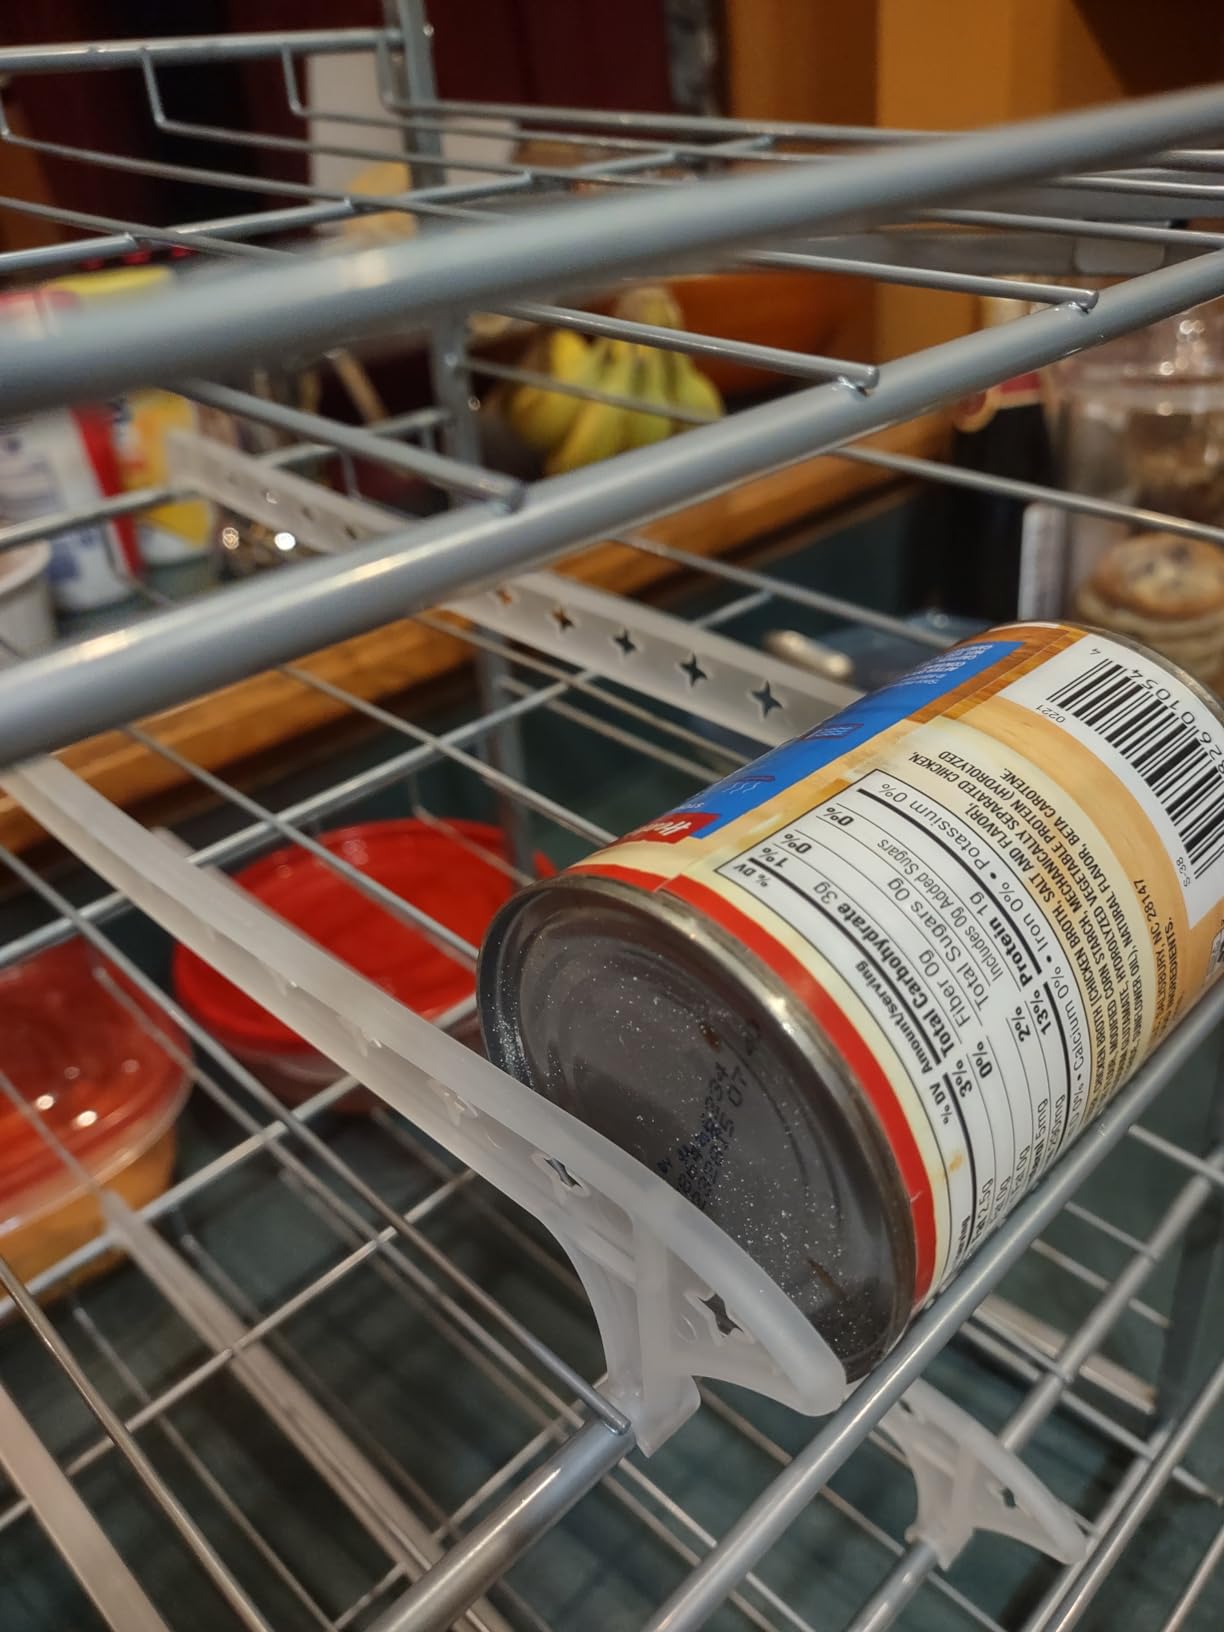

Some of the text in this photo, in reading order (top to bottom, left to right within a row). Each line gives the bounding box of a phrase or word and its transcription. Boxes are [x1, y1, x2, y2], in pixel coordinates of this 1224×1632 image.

[1035, 702, 1065, 724] 0221
[907, 751, 959, 783] CHICKEN,
[937, 750, 1014, 800] (HYDROLYZED
[878, 783, 907, 803] 0%
[957, 778, 1020, 830] SEPARATED
[999, 767, 1055, 818] CAROTENE.
[823, 805, 855, 826] 0%
[908, 799, 990, 869] Potassium
[964, 802, 1012, 849] FLAVOR],
[1009, 798, 1056, 843] PROTEIN
[1053, 815, 1080, 846] BETA
[758, 846, 788, 867] 1%
[780, 832, 812, 853] 0%
[1007, 846, 1035, 872] AND
[733, 863, 757, 876] DV
[1014, 828, 1082, 913] MECHANICALLY
[1027, 871, 1055, 903] SALT
[1050, 840, 1096, 907] VEGETABLE
[1077, 843, 1110, 893] FLAVOR,
[876, 837, 1003, 982] Includes 0g Added Sugars
[998, 881, 1024, 912] 0%
[1105, 890, 1131, 947] NATURAL
[1132, 877, 1155, 922] 28147
[886, 876, 989, 1011] Total Sugars 0g
[968, 890, 1033, 986] Protein 1g
[1021, 912, 1048, 952] Iron
[1050, 899, 1081, 948] BROTH,
[1077, 910, 1104, 965] STARCH,
[1092, 905, 1126, 983] HYDROLYZED
[1148, 921, 1161, 944] NC
[811, 879, 954, 1058] Total Carbohydrate 3g
[917, 949, 971, 1028] Fiber 0g
[1050, 966, 1068, 999] 0%
[1097, 963, 1114, 999] CORN
[853, 959, 932, 1073] Amount/serving
[1011, 1006, 1031, 1041] 2%
[1029, 989, 1051, 1035] 13%
[1063, 999, 1083, 1070] Calcium
[1092, 1004, 1104, 1047] BROTH
[1107, 999, 1117, 1054] MODIFIED
[952, 1059, 972, 1097] 3%
[972, 1041, 993, 1078] 0%
[928, 1082, 946, 1105] DV
[1035, 1097, 1047, 1140] 5mg
[1016, 1144, 1029, 1171] 0g
